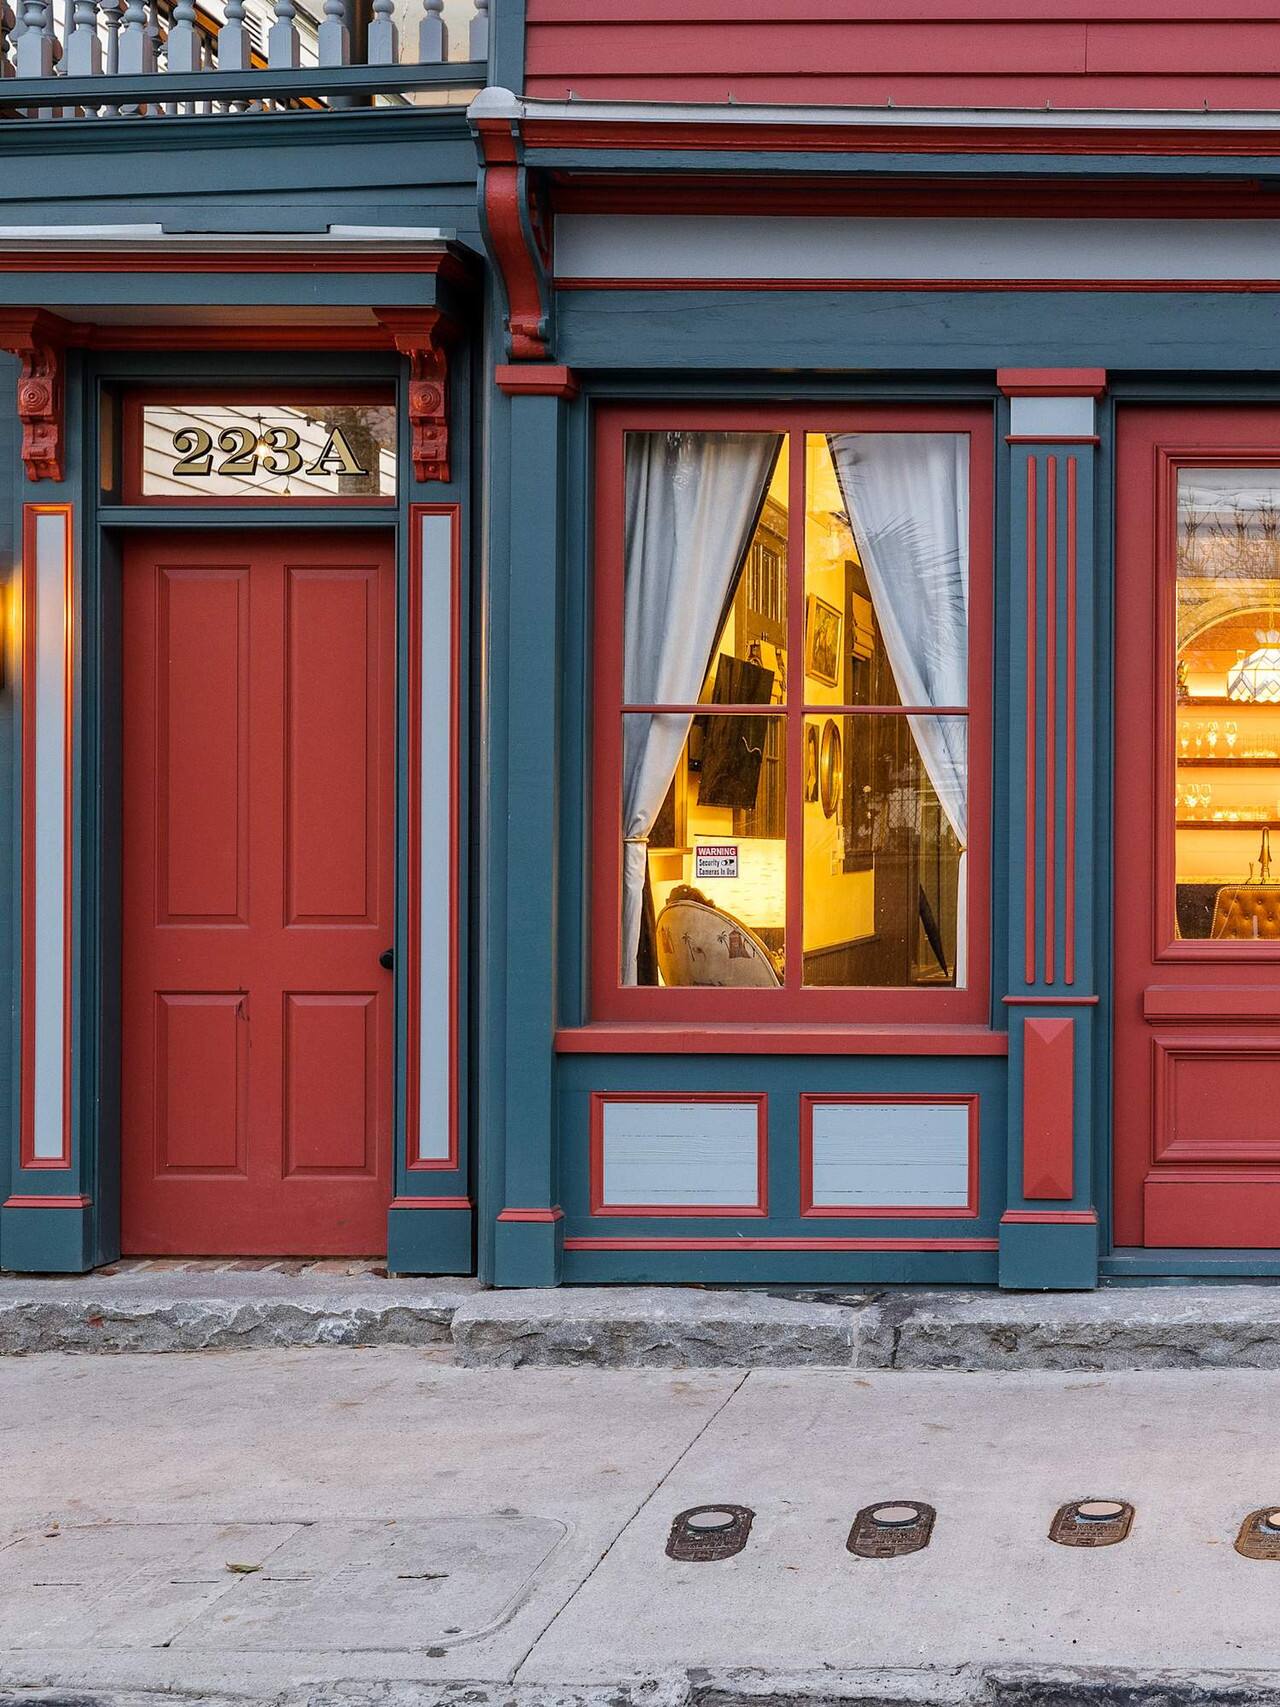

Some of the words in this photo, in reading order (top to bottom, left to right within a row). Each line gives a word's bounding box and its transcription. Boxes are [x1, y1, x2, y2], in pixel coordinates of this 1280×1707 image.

[172, 426, 369, 476] 223A
[698, 847, 736, 855] WARNING
[699, 859, 720, 868] Security
